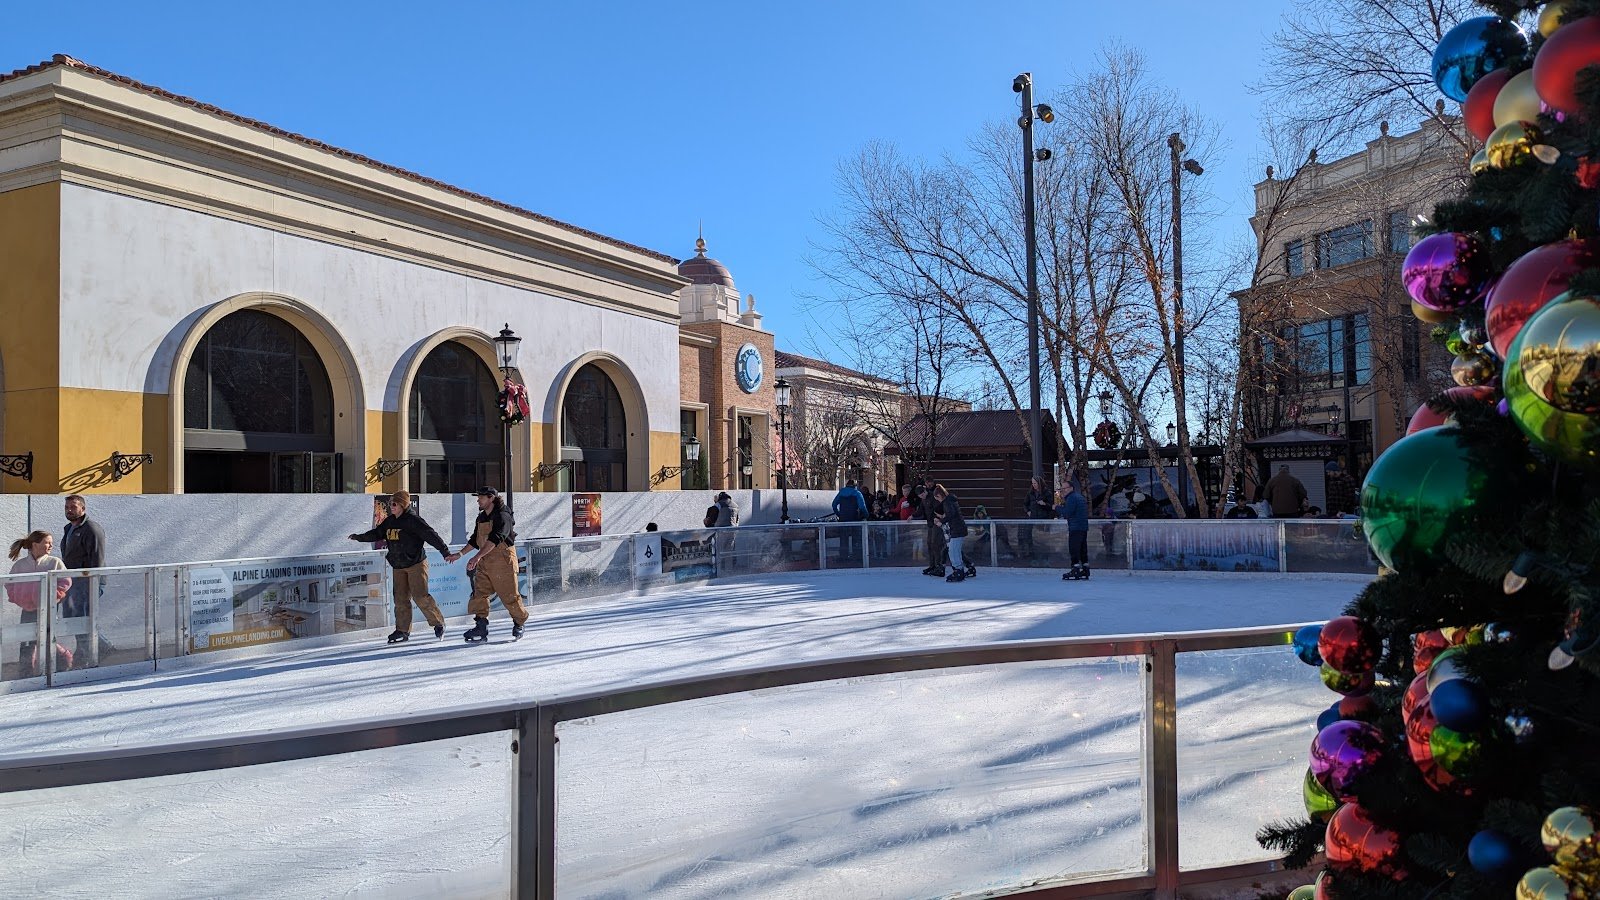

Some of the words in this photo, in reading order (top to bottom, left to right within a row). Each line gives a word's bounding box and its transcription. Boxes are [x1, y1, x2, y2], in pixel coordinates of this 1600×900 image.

[386, 528, 402, 540] CAT
[232, 569, 259, 581] ALPINE
[261, 566, 291, 579] LANDING
[293, 563, 335, 576] TOWNHOMES
[212, 629, 284, 647] LIVEALPINELANDING.COM
